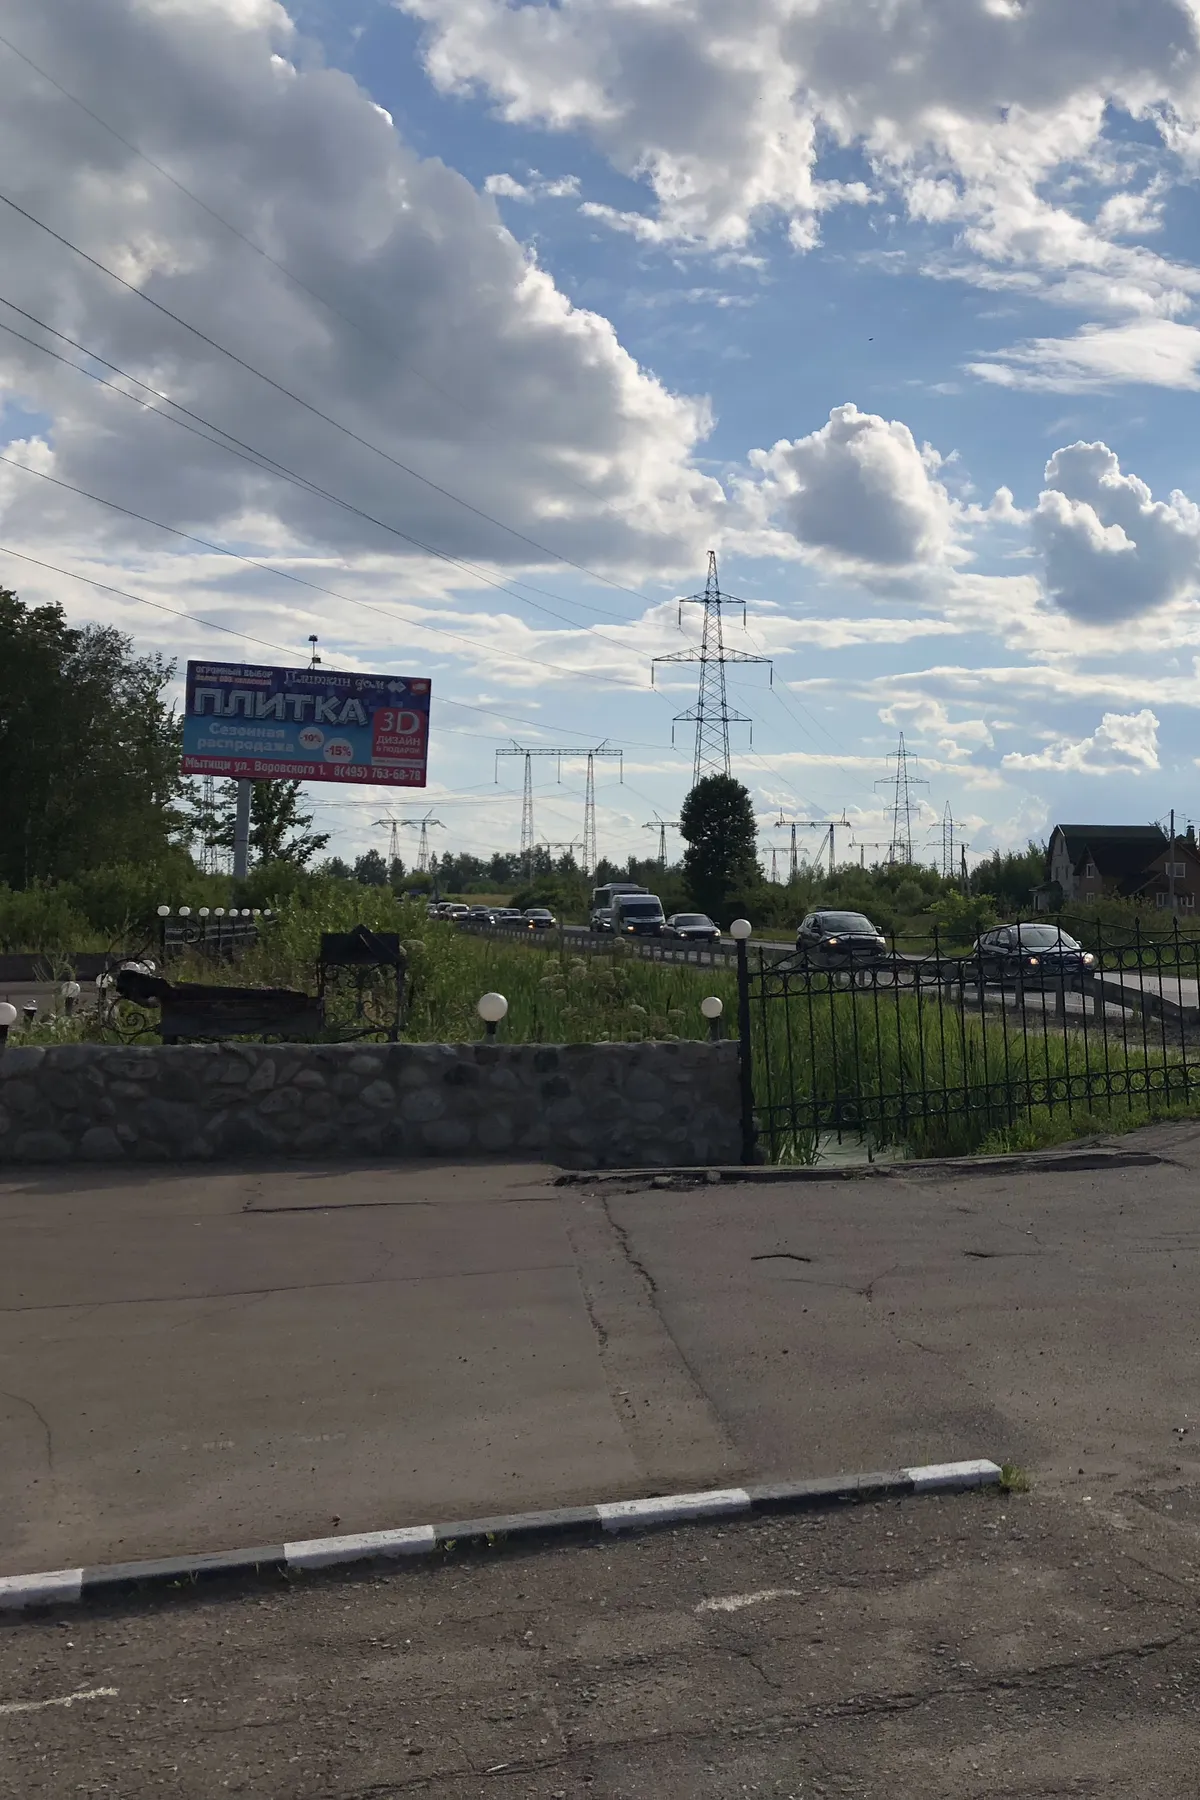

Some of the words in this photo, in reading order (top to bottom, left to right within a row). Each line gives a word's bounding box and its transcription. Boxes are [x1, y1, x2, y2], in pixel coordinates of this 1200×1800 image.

[243, 668, 273, 678] ВЫБОР
[193, 687, 369, 726] ПЛИТКА
[208, 722, 285, 739] Сезонная
[380, 711, 420, 734] 3D
[197, 738, 294, 753] распродажа
[376, 735, 421, 746] ДИЗАЙН
[325, 745, 352, 757] -15%
[185, 757, 231, 771] Мытищи
[234, 763, 250, 772] ул.
[254, 761, 314, 775] Воровского
[334, 765, 368, 778] 8(495)
